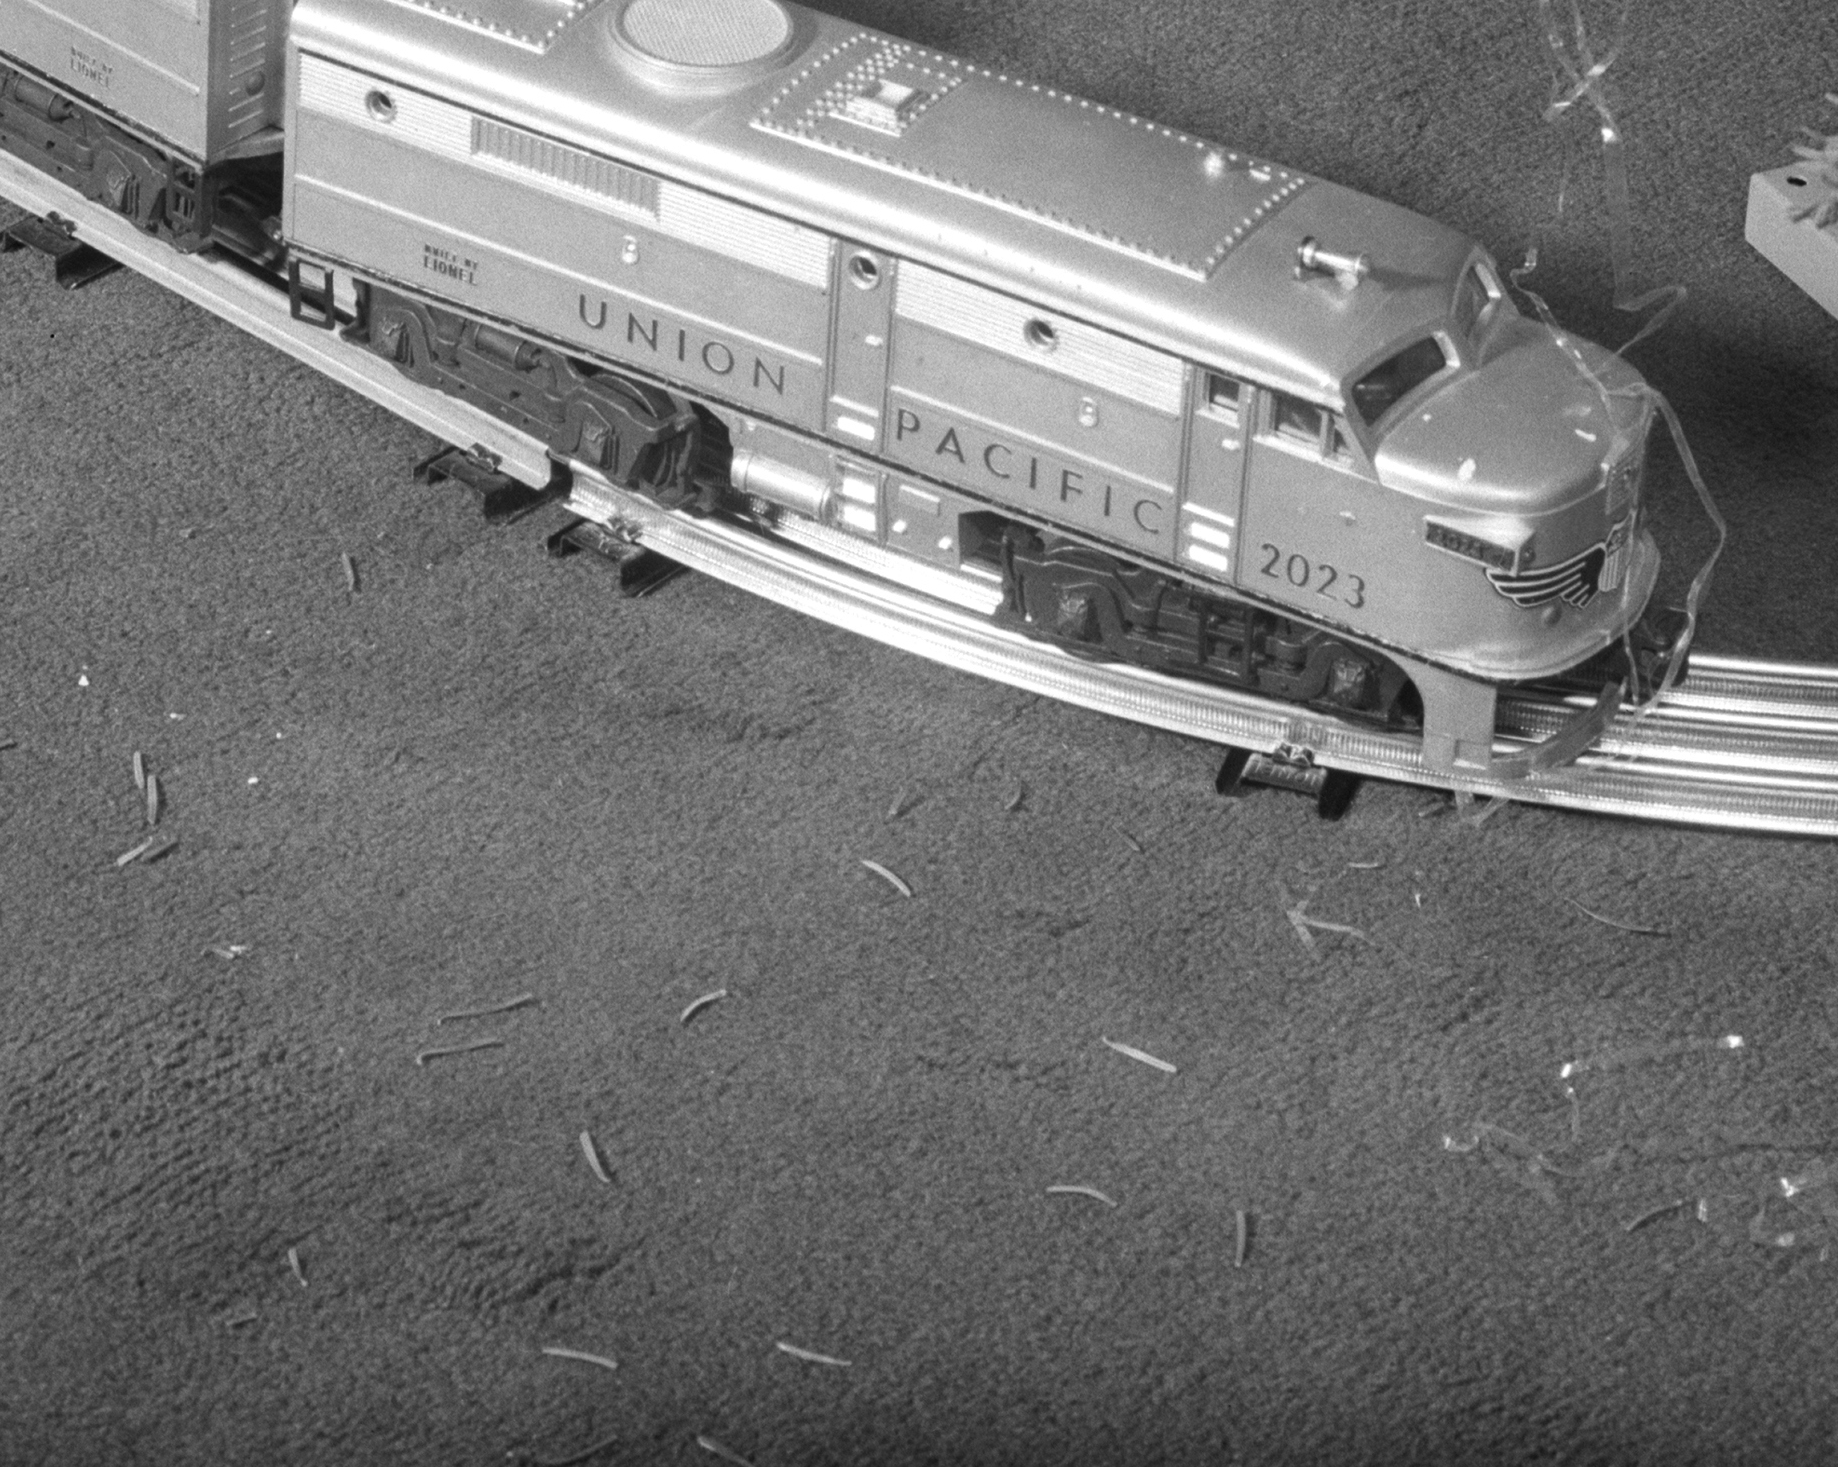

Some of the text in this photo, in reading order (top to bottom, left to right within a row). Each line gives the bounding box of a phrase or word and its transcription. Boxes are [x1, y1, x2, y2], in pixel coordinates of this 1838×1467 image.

[70, 58, 112, 91] LIONEL
[423, 254, 478, 287] LIONEL
[578, 293, 785, 396] UNION
[896, 407, 1163, 535] PACIFIC
[1261, 542, 1365, 609] 2023
